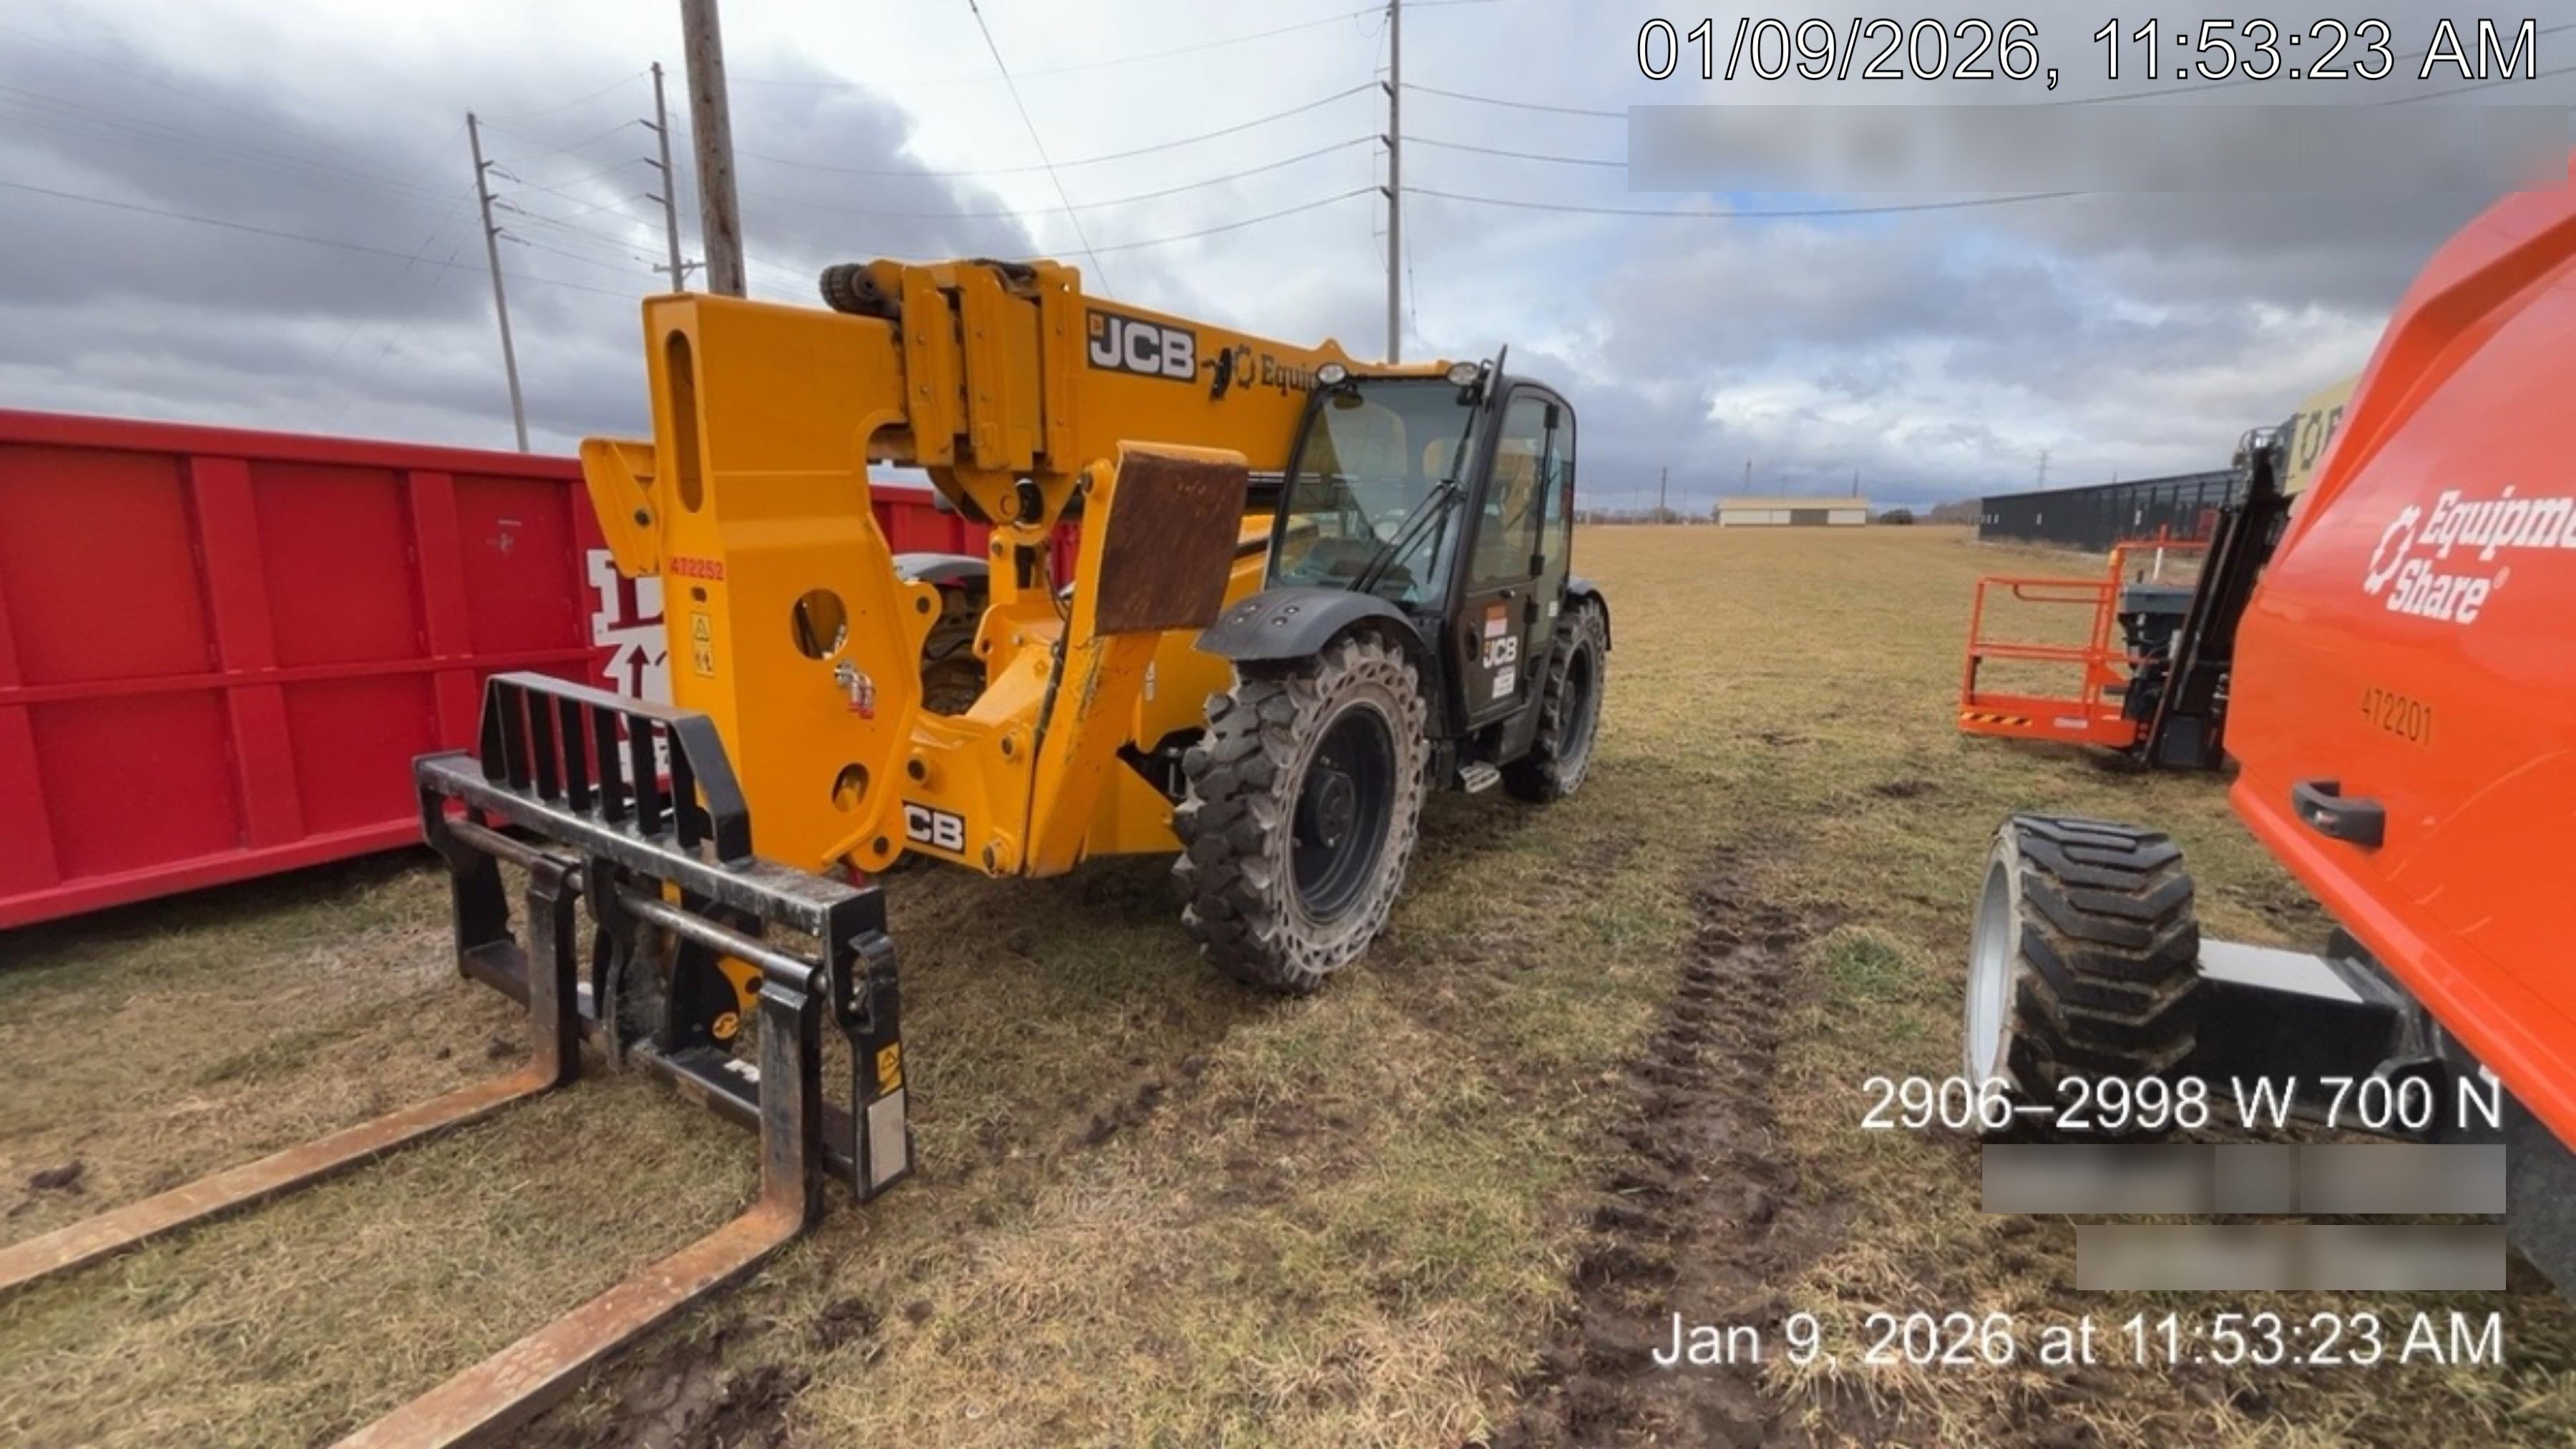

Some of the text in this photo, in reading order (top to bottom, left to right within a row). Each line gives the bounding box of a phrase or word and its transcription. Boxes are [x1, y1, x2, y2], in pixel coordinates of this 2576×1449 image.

[1090, 317, 1194, 379] JCB
[670, 557, 724, 581] 472252
[1483, 635, 1518, 668] JCB
[2361, 686, 2431, 747] 472201
[904, 804, 963, 850] CB
